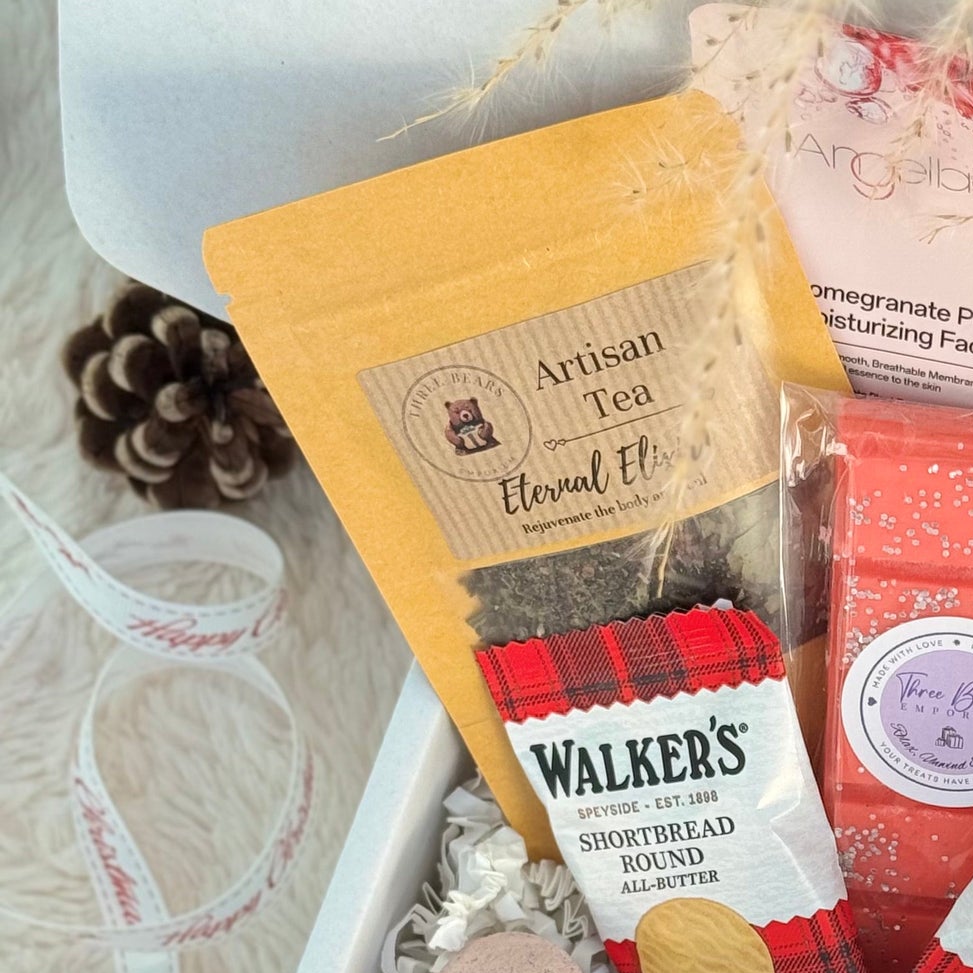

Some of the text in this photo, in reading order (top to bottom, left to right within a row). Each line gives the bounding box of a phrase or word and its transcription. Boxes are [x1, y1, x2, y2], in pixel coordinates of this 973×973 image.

[810, 284, 952, 323] omegranate
[535, 330, 667, 391] Artisan
[872, 358, 926, 378] Breathable
[848, 367, 889, 383] essence
[891, 374, 902, 386] to
[904, 377, 919, 389] the
[921, 381, 942, 394] skin
[582, 384, 656, 421] Tea
[498, 449, 610, 516] Eternal
[521, 510, 593, 535] Rejuvenate
[594, 504, 617, 518] the
[618, 493, 650, 513] body
[872, 639, 944, 689] MADE WITH LOVE
[895, 671, 945, 704] Three
[878, 741, 902, 765] YOUR
[901, 762, 940, 783] TREATS
[943, 776, 971, 785] HAVE
[576, 800, 641, 820] SPEYSIDE
[654, 794, 686, 811] EST.
[579, 815, 736, 853] SHORTBREAD
[619, 846, 705, 874] ROUND
[620, 869, 720, 894] ALL-BUTTER
